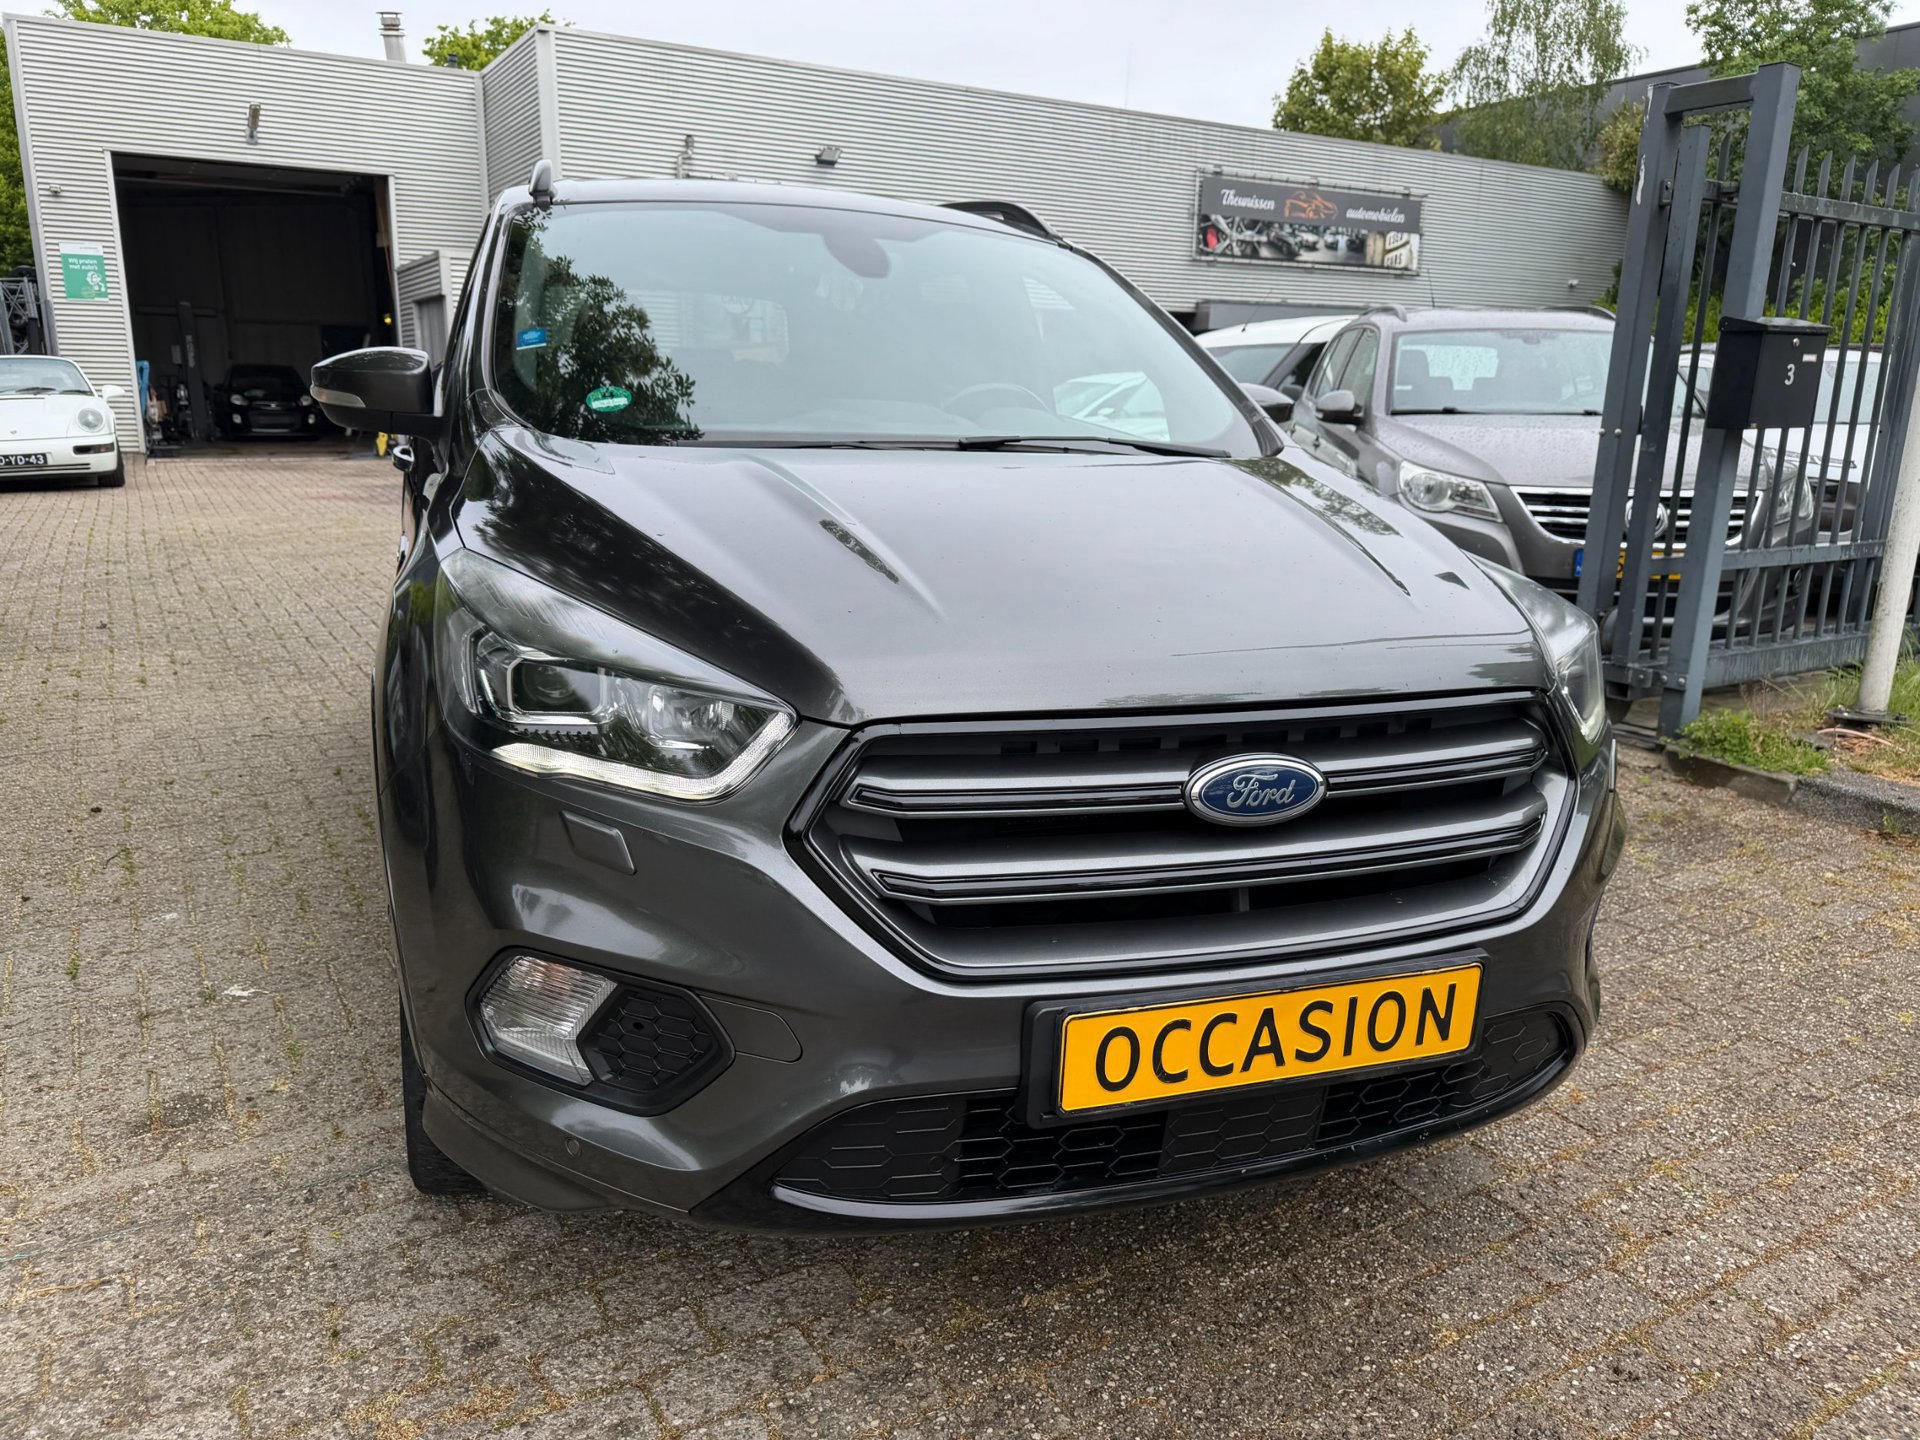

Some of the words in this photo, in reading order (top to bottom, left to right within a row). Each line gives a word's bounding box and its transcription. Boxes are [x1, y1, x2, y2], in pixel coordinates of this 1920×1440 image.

[1221, 189, 1275, 210] Theunissen
[1784, 363, 1796, 386] 3
[1226, 773, 1297, 808] Ford
[1095, 983, 1457, 1092] OCCASION
